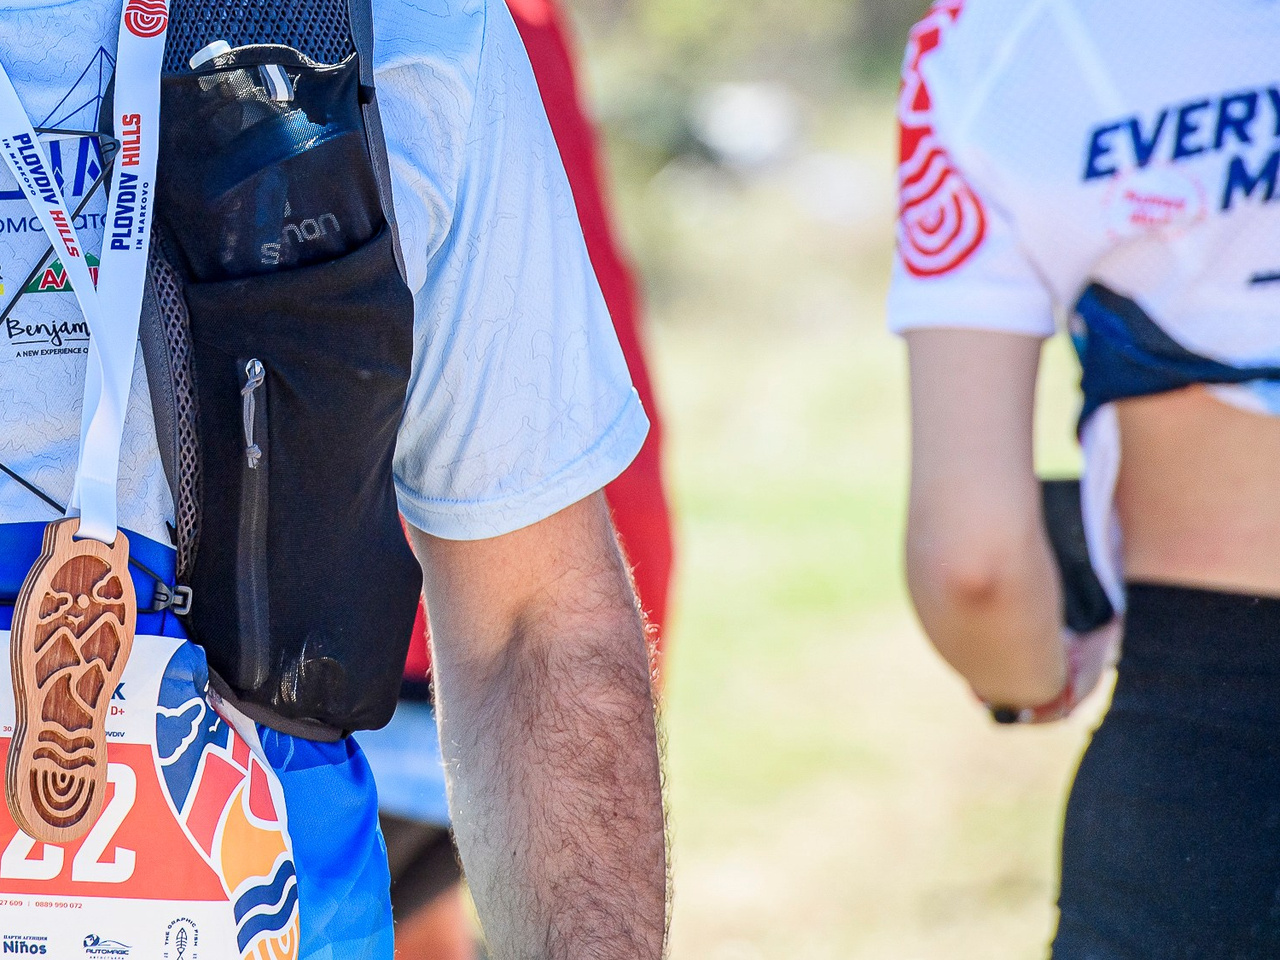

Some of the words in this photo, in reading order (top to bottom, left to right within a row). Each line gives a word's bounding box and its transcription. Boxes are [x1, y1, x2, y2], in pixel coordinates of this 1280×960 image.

[122, 113, 141, 167] HILLS
[2, 138, 12, 149] IN
[9, 153, 37, 197] MARKOVO
[12, 133, 60, 206] PLOVDIV
[49, 210, 80, 258] HILLS
[110, 171, 139, 251] PLOVDIV
[137, 181, 149, 234] MARKOVO
[135, 238, 143, 250] IN
[40, 348, 82, 356] EXPERIENCE
[3, 940, 48, 955] Niños
